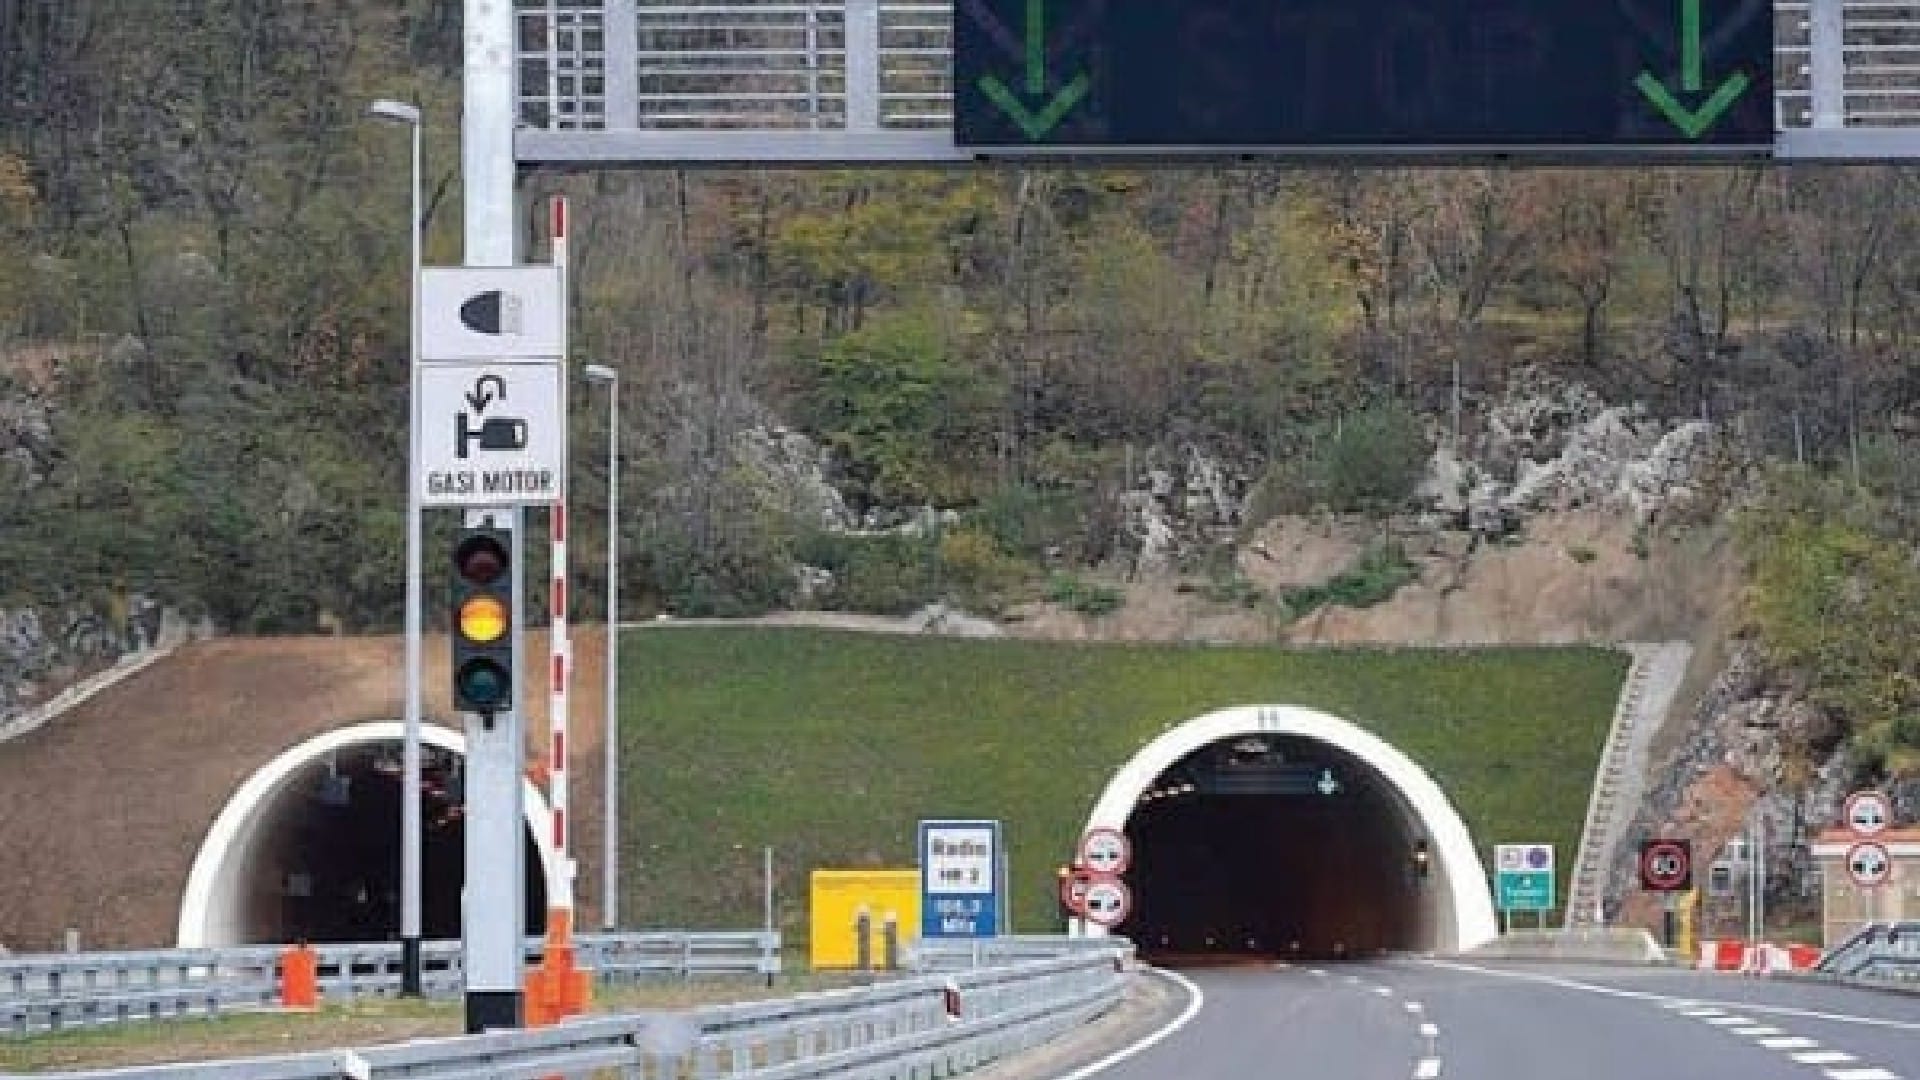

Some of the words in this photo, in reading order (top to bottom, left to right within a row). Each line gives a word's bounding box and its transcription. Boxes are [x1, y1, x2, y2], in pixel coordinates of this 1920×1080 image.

[428, 470, 475, 494] GASI
[482, 470, 554, 494] MOTOR
[931, 838, 987, 856] Radio
[1651, 854, 1680, 875] 60
